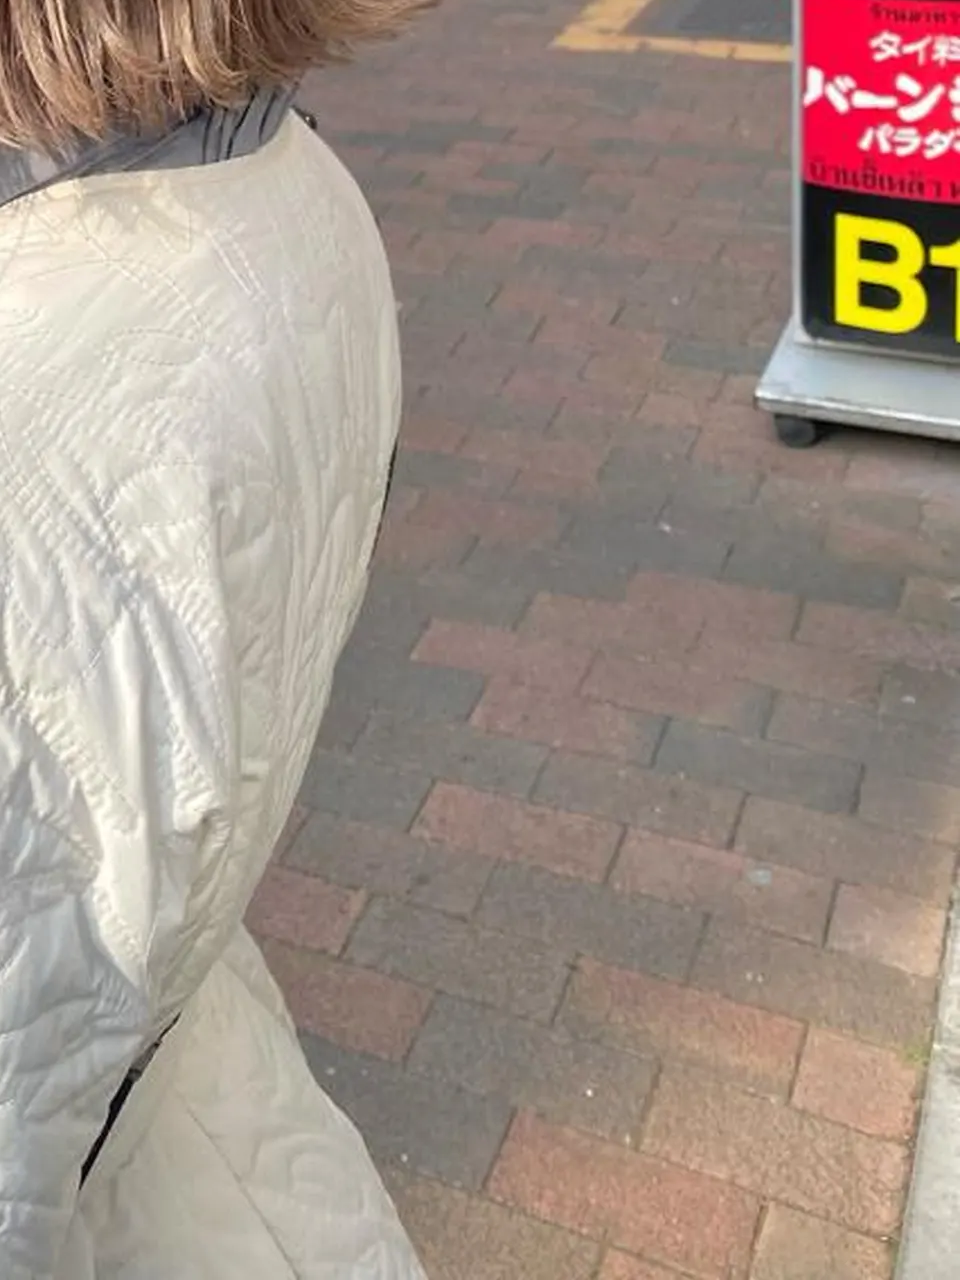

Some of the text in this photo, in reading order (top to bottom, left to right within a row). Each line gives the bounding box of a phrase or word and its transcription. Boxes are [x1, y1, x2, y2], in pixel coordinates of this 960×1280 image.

[803, 66, 960, 123] バーン
[857, 122, 960, 160] パラダ
